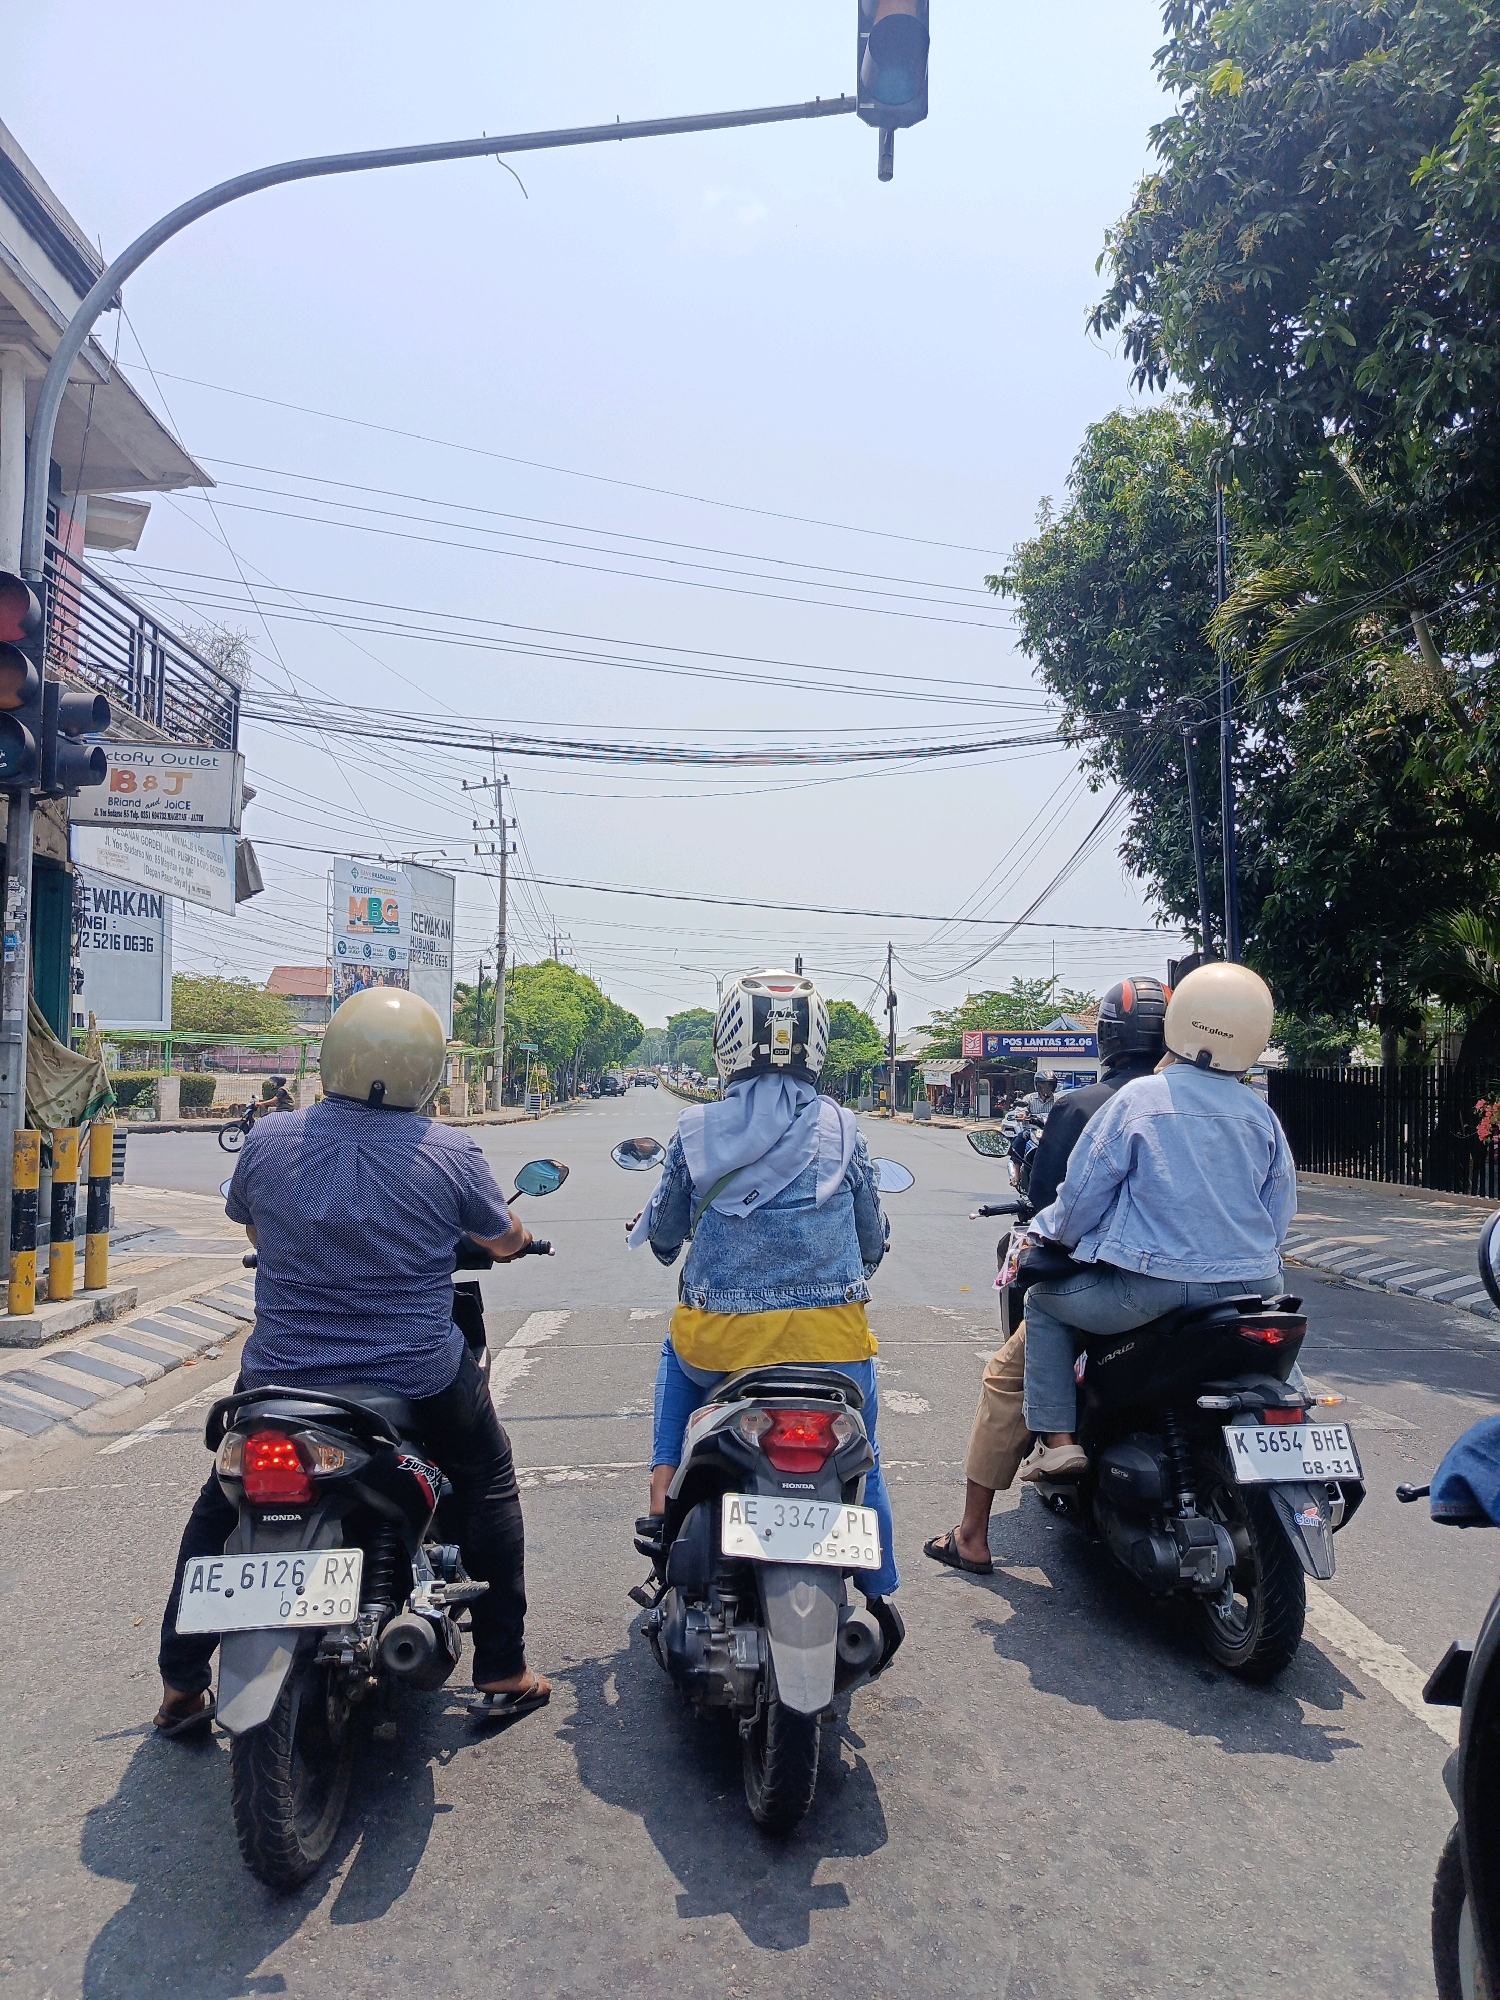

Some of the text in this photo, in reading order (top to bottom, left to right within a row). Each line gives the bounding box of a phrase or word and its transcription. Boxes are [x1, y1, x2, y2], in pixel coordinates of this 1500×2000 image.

[106, 751, 219, 767] ctoRy Outlet
[110, 768, 138, 794] B
[162, 770, 193, 795] J
[145, 797, 161, 809] and
[164, 800, 191, 810] JoiCE
[111, 838, 123, 850] Yos
[124, 842, 145, 858] Sudarso
[352, 885, 373, 895] KREDIT
[83, 887, 163, 919] EWAKAN
[349, 896, 399, 925] MBG
[411, 911, 451, 940] ISEWAKAN
[93, 932, 120, 950] 5216
[124, 935, 154, 952] 0636
[765, 1008, 799, 1024] INK
[1191, 1020, 1234, 1039] Cargloss
[1003, 1037, 1093, 1046] POS LANTAS 12.06
[1234, 1429, 1348, 1454] K 5654 BHE
[782, 1482, 816, 1490] HONDA
[262, 1513, 302, 1522] HONDA
[729, 1500, 873, 1536] AE 3347 PL
[189, 1556, 355, 1594] AE 6126 RX
